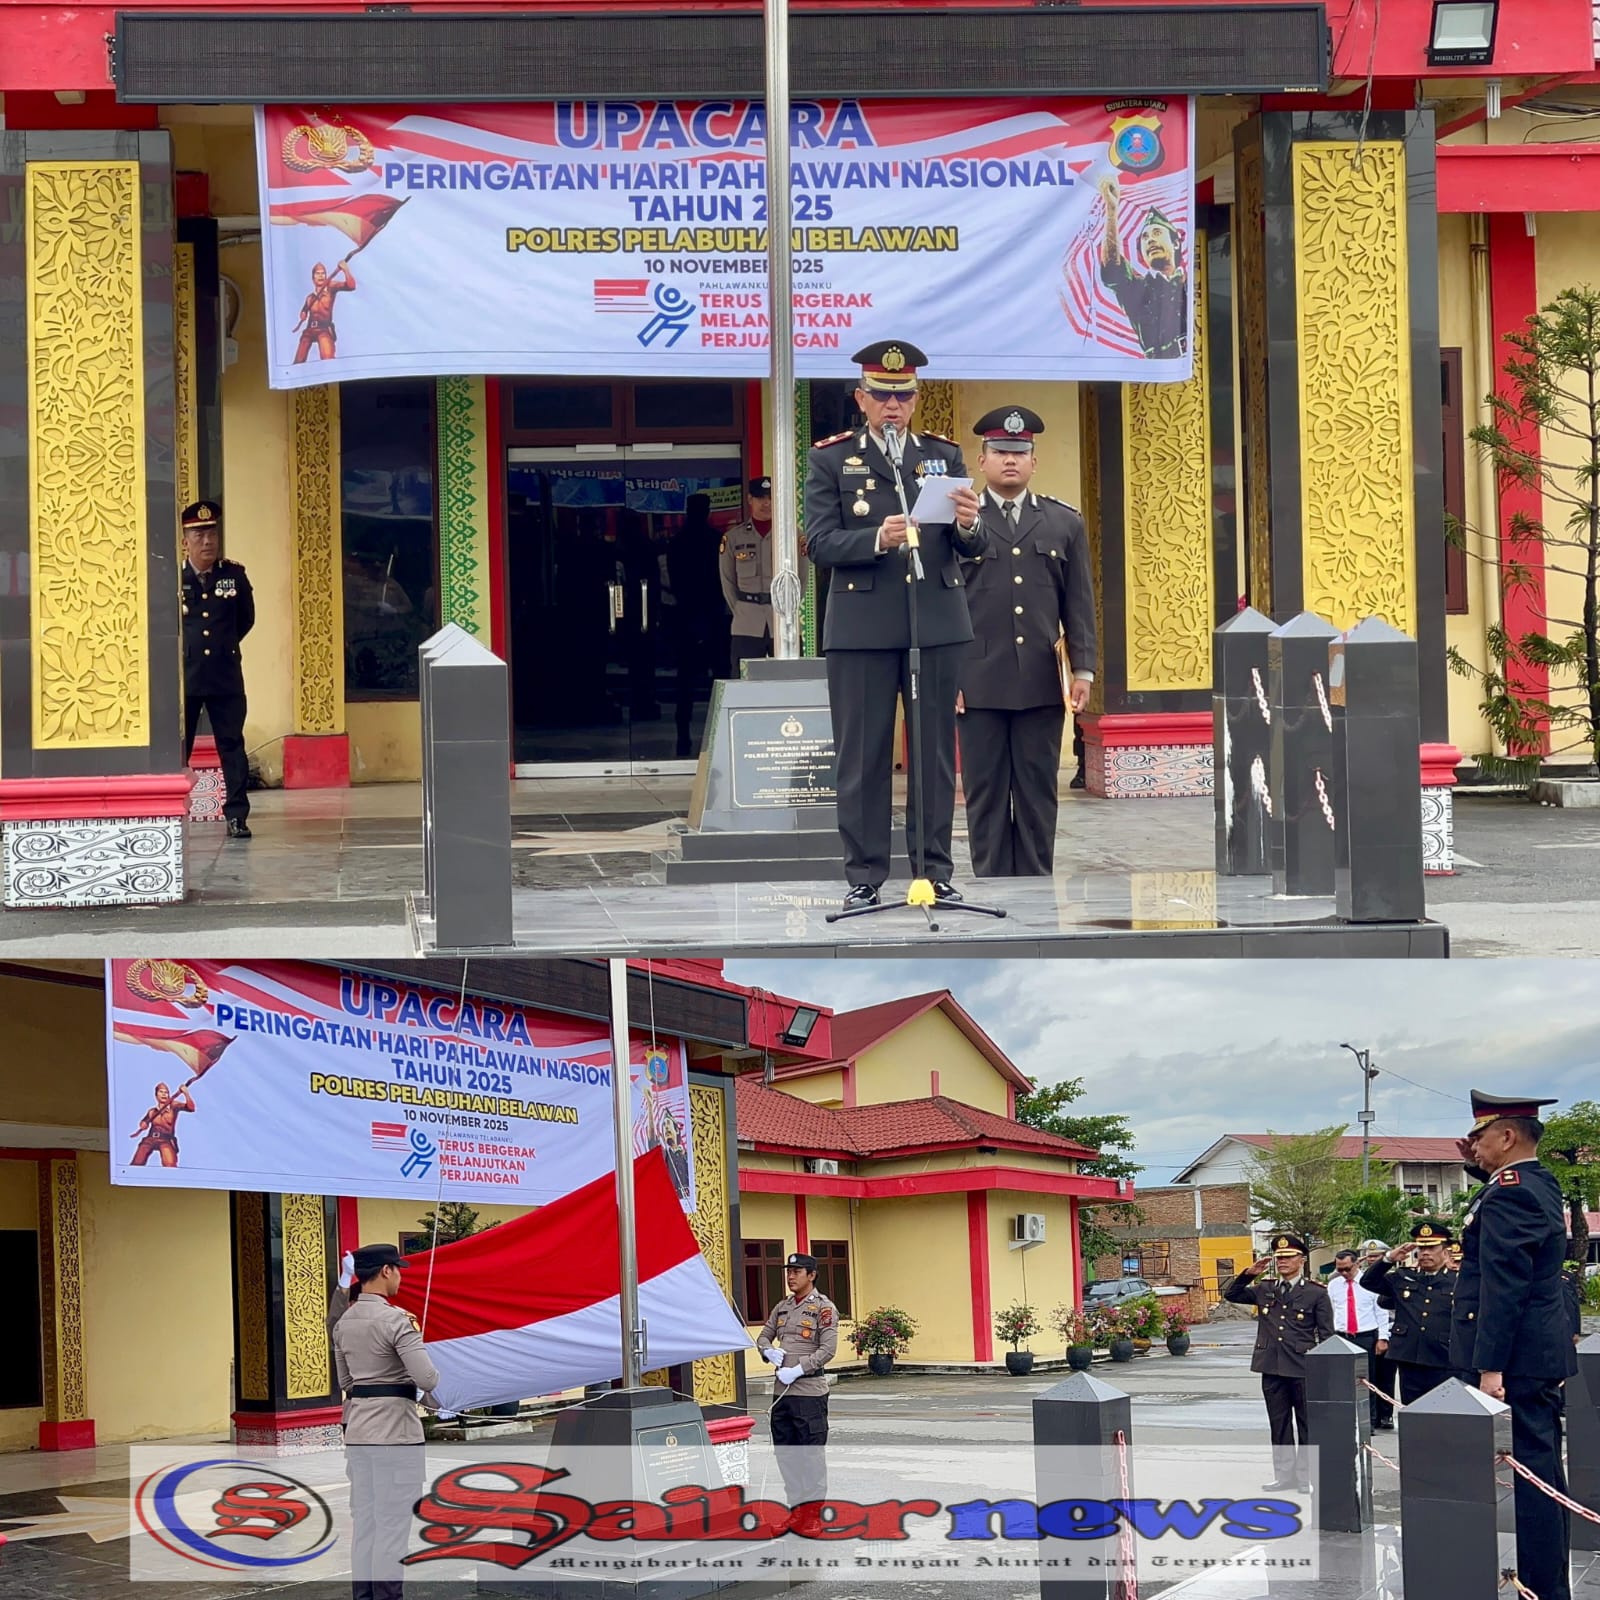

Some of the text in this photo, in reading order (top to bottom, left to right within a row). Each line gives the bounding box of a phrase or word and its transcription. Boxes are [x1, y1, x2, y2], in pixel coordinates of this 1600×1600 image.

[556, 101, 875, 149] UPACARA
[385, 160, 1073, 190] PERINGATAN HARI PAHAWAN NASIONAL
[629, 194, 833, 221] TAHUN 225
[507, 228, 620, 253] POLRES
[807, 226, 959, 252] BELAWAN
[644, 259, 664, 273] 10
[792, 259, 823, 273] 025
[699, 282, 768, 290] PAHLAWANKU
[700, 293, 873, 308] TERUS RGERAK
[700, 312, 853, 328] MELANTKAN
[701, 332, 839, 348] PERJUAGAN
[340, 977, 532, 1046] UPACARA
[216, 1003, 611, 1087] PERINGATAN HARI PAHLAWAN NASION
[391, 1058, 512, 1094] TAHUN 2025
[310, 1072, 579, 1124] POLRES PELABUHAN BELAWAN
[403, 1109, 509, 1131] 10 NOVEMBER 2025
[438, 1139, 536, 1158] TERUS BERGERAK
[439, 1154, 526, 1171] MELANJUTKAN
[440, 1169, 519, 1184] PERJUANGAN
